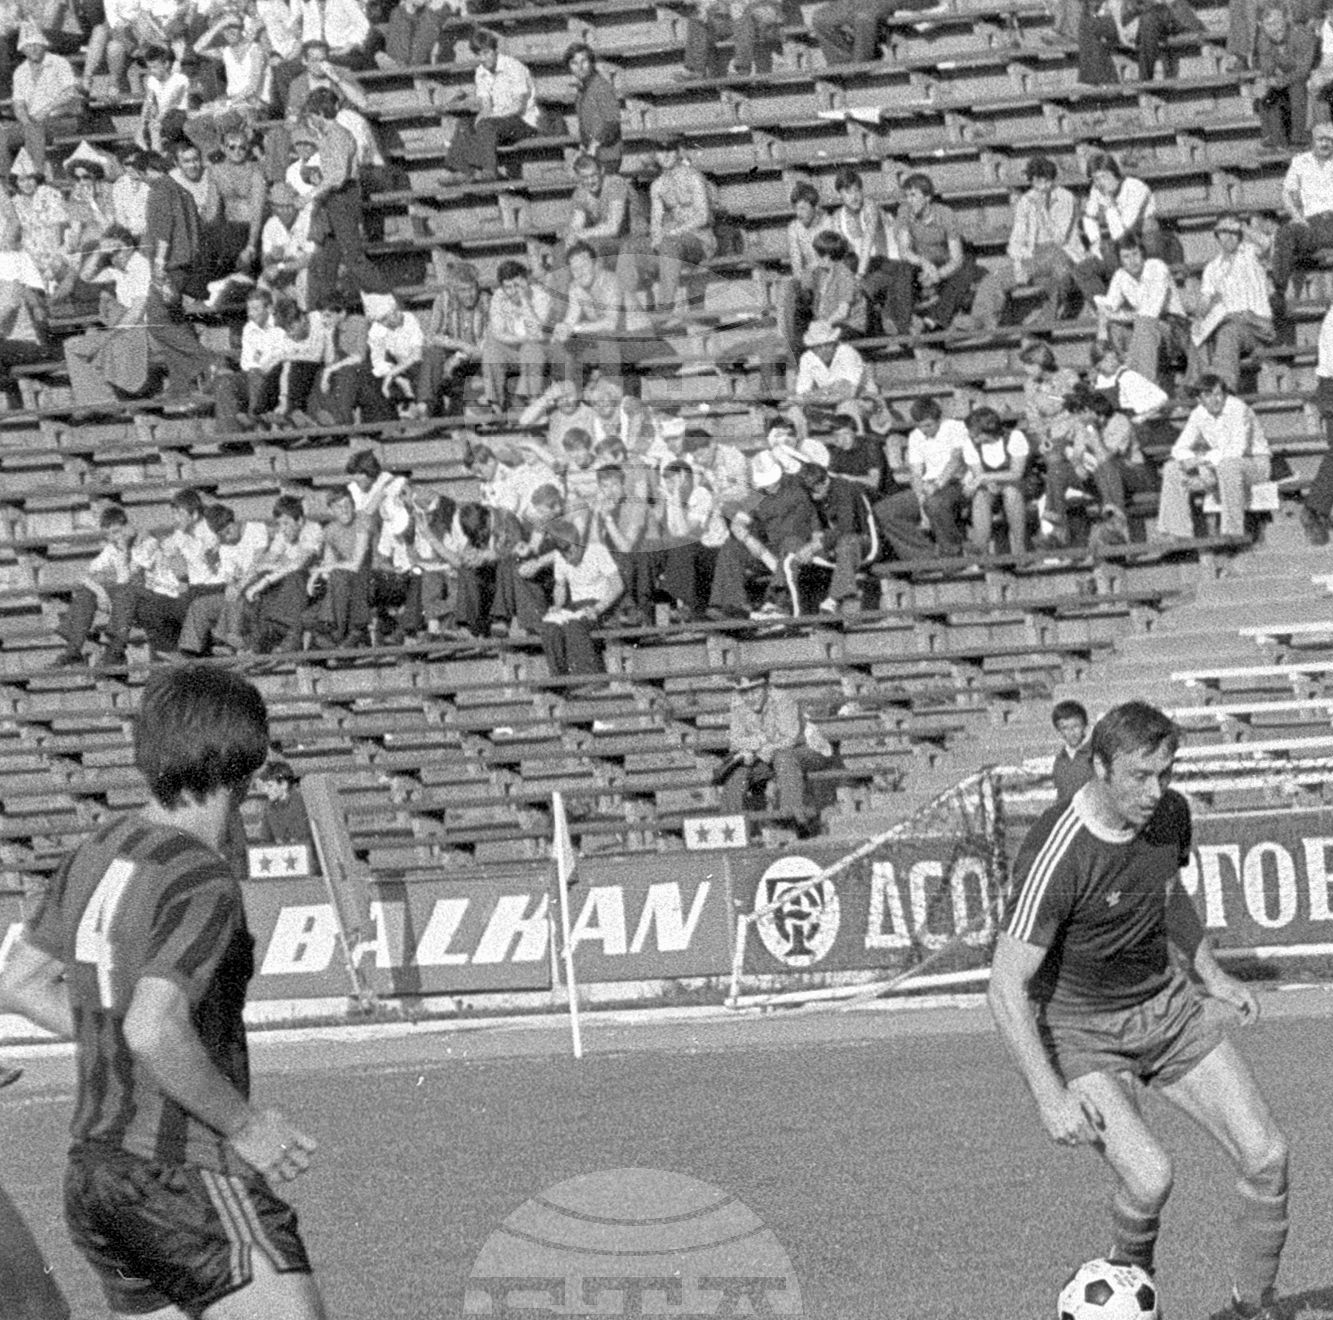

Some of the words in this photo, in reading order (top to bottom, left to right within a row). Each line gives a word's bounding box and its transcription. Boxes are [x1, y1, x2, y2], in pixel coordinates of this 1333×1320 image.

[75, 857, 136, 1009] 4
[259, 880, 711, 976] BALKAN
[865, 856, 993, 950] ДСО
